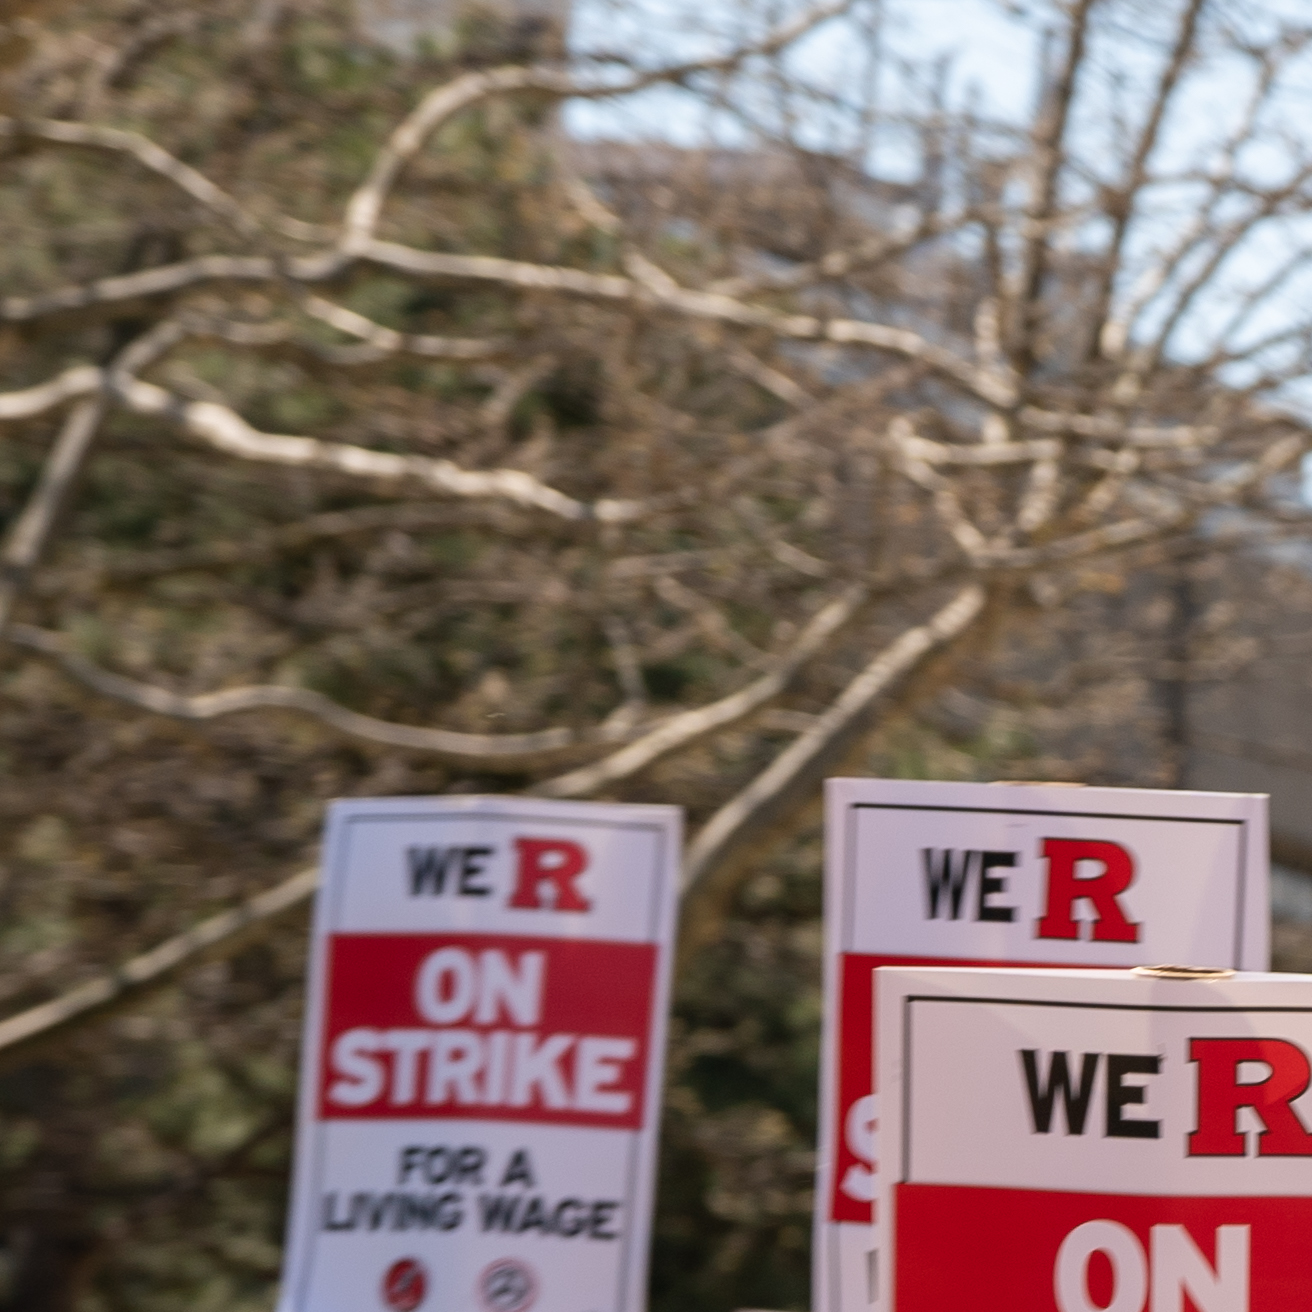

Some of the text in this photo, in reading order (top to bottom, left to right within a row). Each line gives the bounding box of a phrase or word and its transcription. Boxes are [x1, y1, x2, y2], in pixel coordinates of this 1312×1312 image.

[406, 836, 591, 913] WE R
[920, 836, 1141, 944] WE R
[415, 947, 545, 1026] ON
[328, 1028, 637, 1114] STRIKE
[1018, 1048, 1163, 1138] WE
[398, 1145, 537, 1188] FOR A
[320, 1192, 623, 1240] LIVING WAGE
